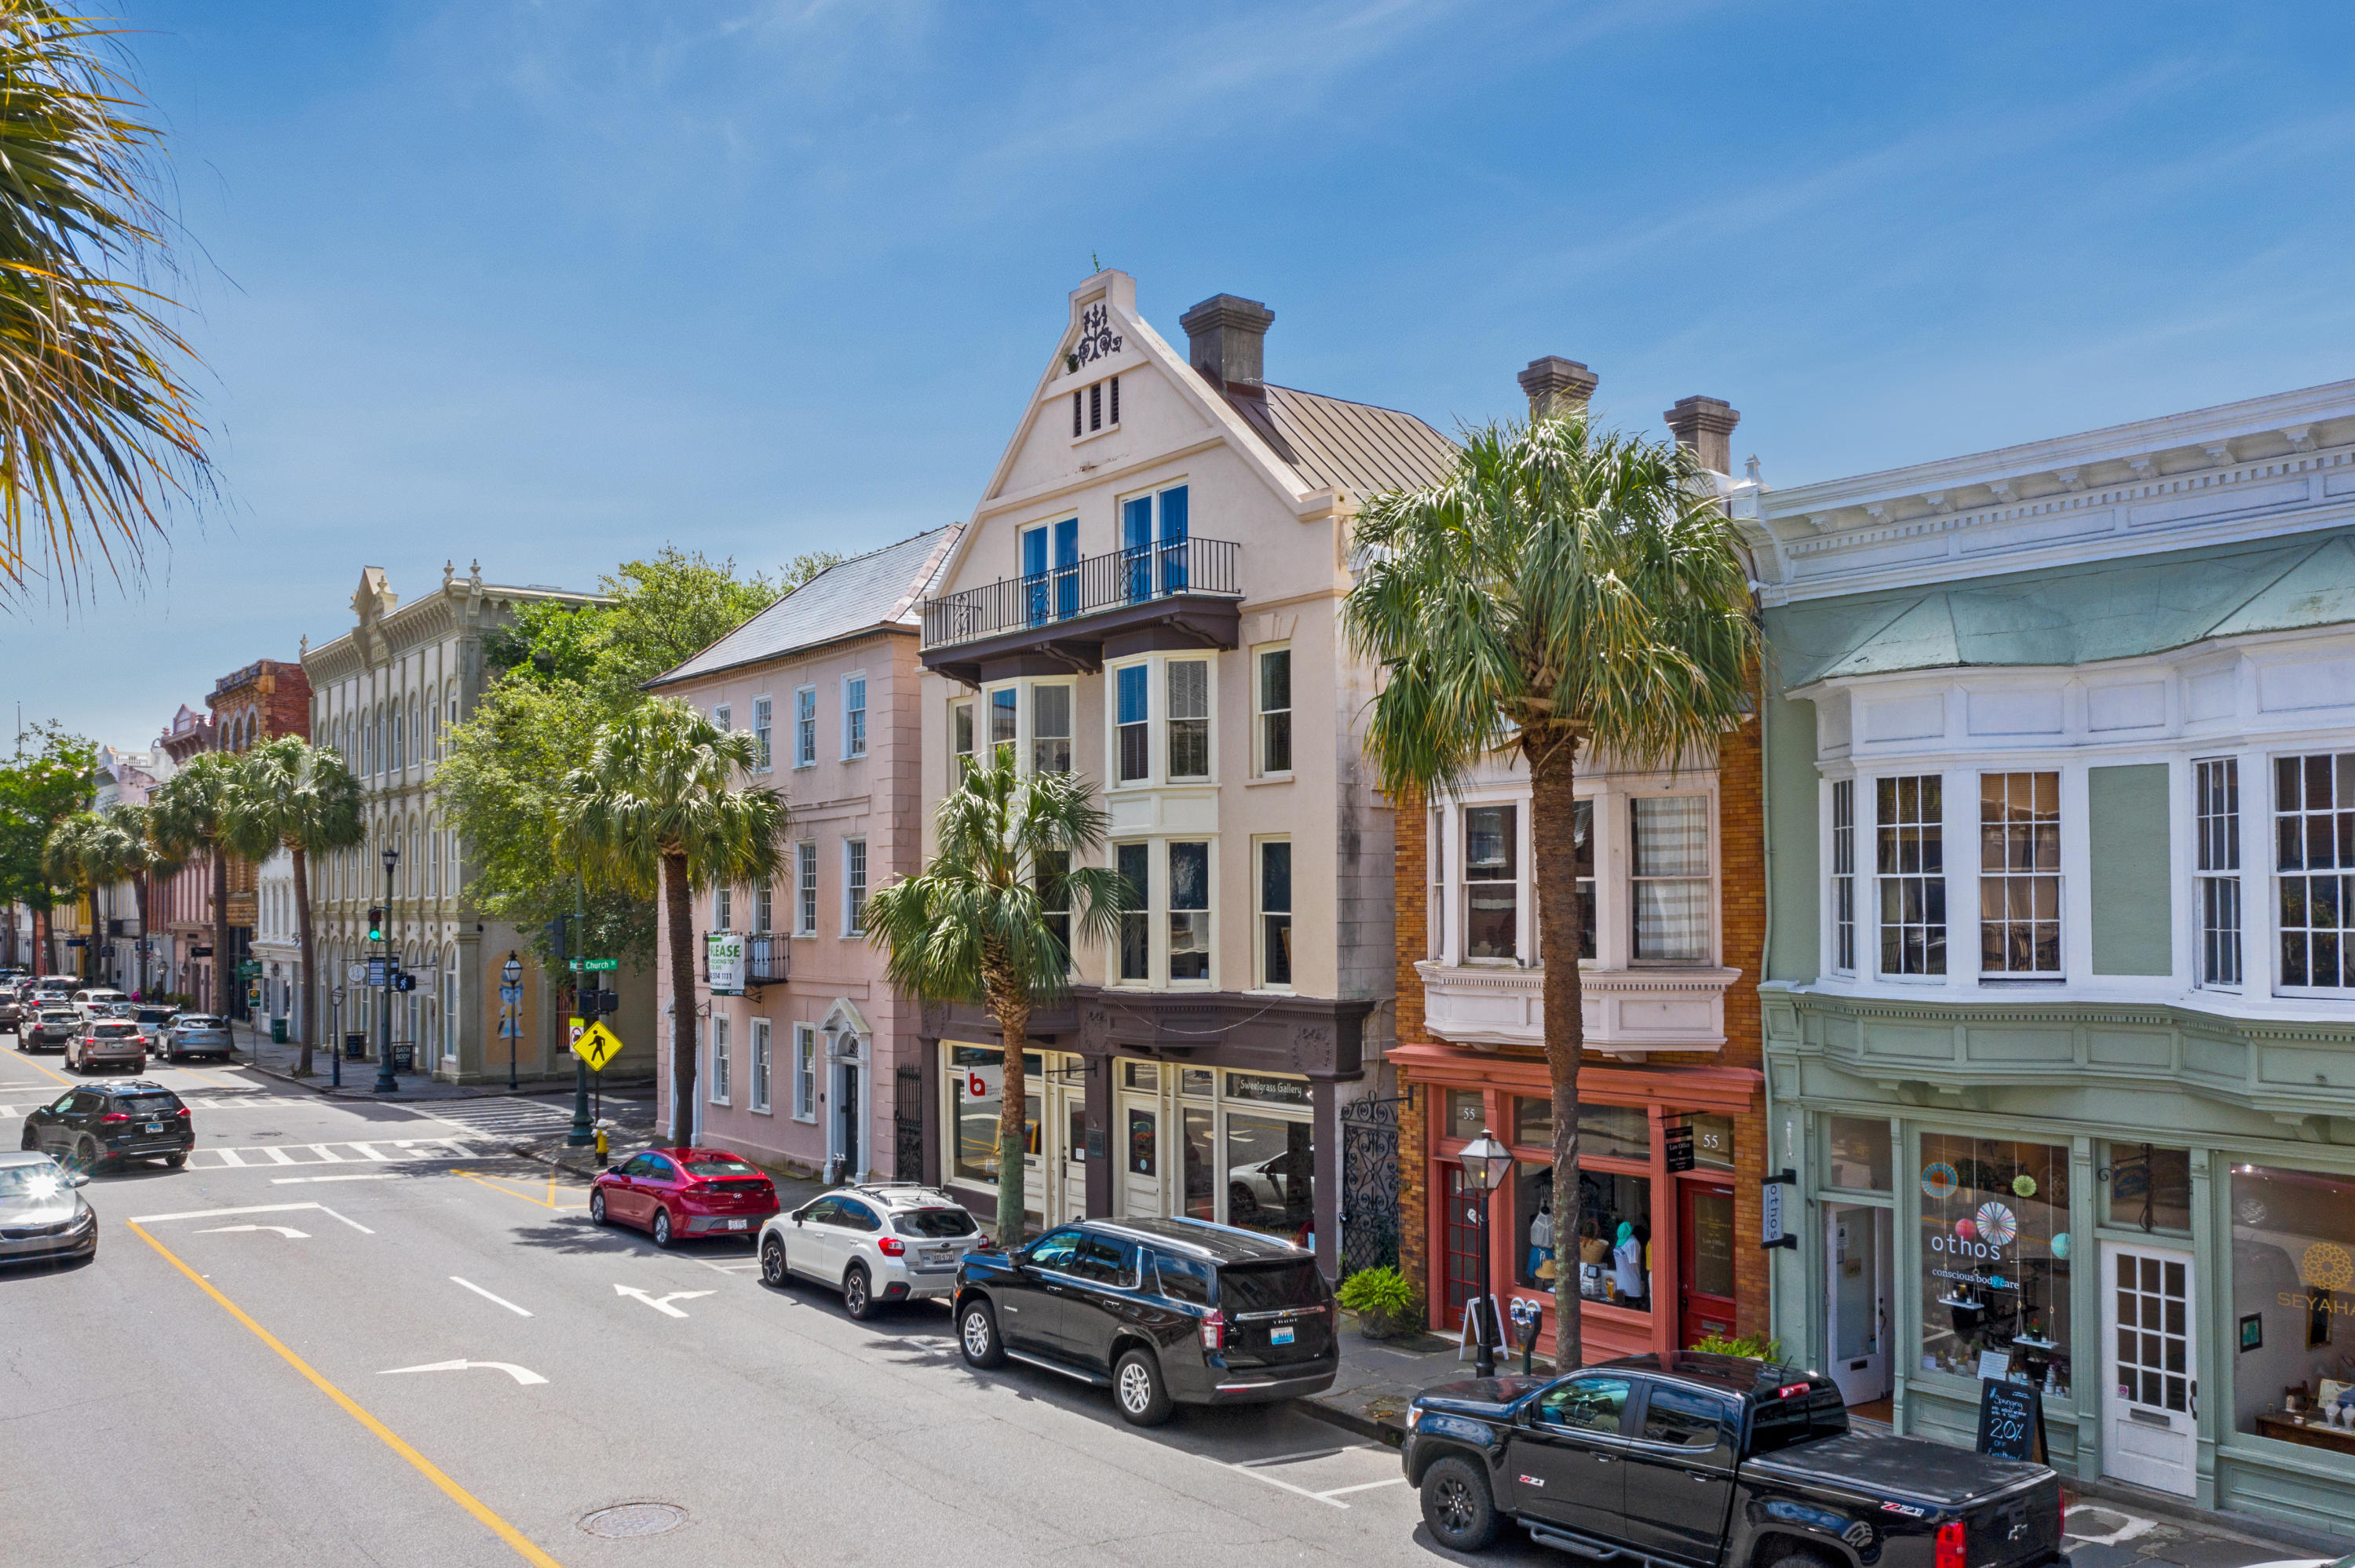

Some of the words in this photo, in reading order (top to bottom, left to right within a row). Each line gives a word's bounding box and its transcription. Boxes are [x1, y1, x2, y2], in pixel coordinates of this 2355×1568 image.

[586, 961, 608, 970] Church
[1277, 1083, 1302, 1098] Gallery
[1463, 1107, 1475, 1120] 55
[1703, 1134, 1718, 1149] 55
[1770, 1185, 1779, 1239] othos
[1931, 1234, 2001, 1260] othos
[1932, 1268, 1974, 1282] conscious
[1976, 1274, 1998, 1287] body
[1999, 1279, 2020, 1289] care
[1990, 1418, 2024, 1441] 20%
[1881, 1501, 1925, 1518] Z71
